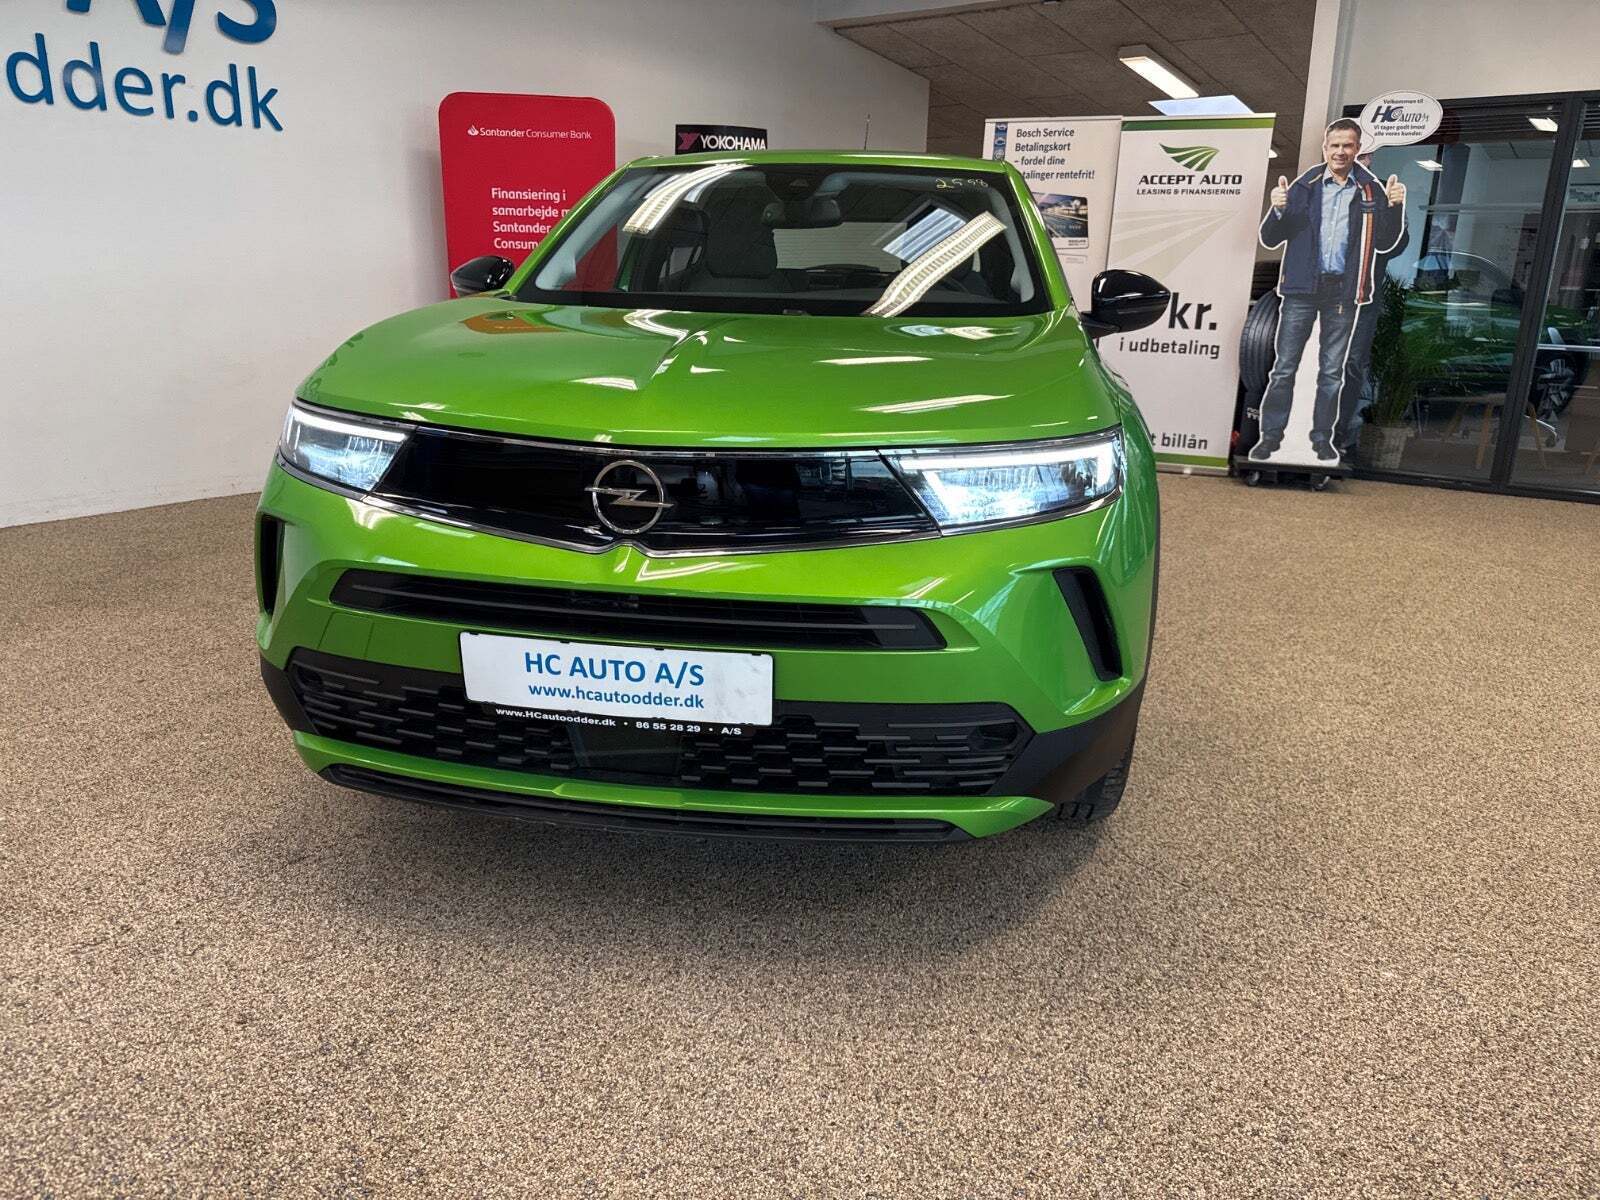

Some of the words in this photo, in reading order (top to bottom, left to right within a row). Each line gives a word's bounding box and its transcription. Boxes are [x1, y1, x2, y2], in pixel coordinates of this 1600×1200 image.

[480, 127, 525, 137] Santander
[526, 129, 569, 138] Consumer
[570, 131, 592, 139] Bank
[1016, 128, 1041, 138] Bosch
[1043, 127, 1075, 137] Service
[701, 135, 767, 150] YOKOHAMA
[1015, 142, 1071, 153] Betalingskort
[1021, 155, 1046, 166] fordel
[1047, 155, 1066, 166] dine
[1056, 169, 1095, 180] rentefrit!
[1138, 175, 1195, 185] ACCEPT
[1200, 175, 1243, 185] AUTO
[491, 187, 560, 203] Finansiering
[562, 189, 567, 201] i
[492, 205, 559, 220] samarbejde
[493, 221, 552, 233] Santander
[1168, 292, 1217, 331] kr.
[1120, 337, 1125, 352] i
[1129, 338, 1220, 359] udbetaling
[1161, 432, 1208, 450] billån
[525, 652, 562, 676] HC
[569, 656, 646, 683] AUTO
[655, 662, 705, 689] A/S
[528, 684, 705, 709] www.hcautoodder.dk
[495, 708, 617, 727] www.HCautoodder.dk
[635, 721, 650, 729] 86
[652, 722, 667, 730] 55
[669, 723, 684, 732] 28
[686, 724, 701, 733] 29
[721, 727, 742, 735] A/S
